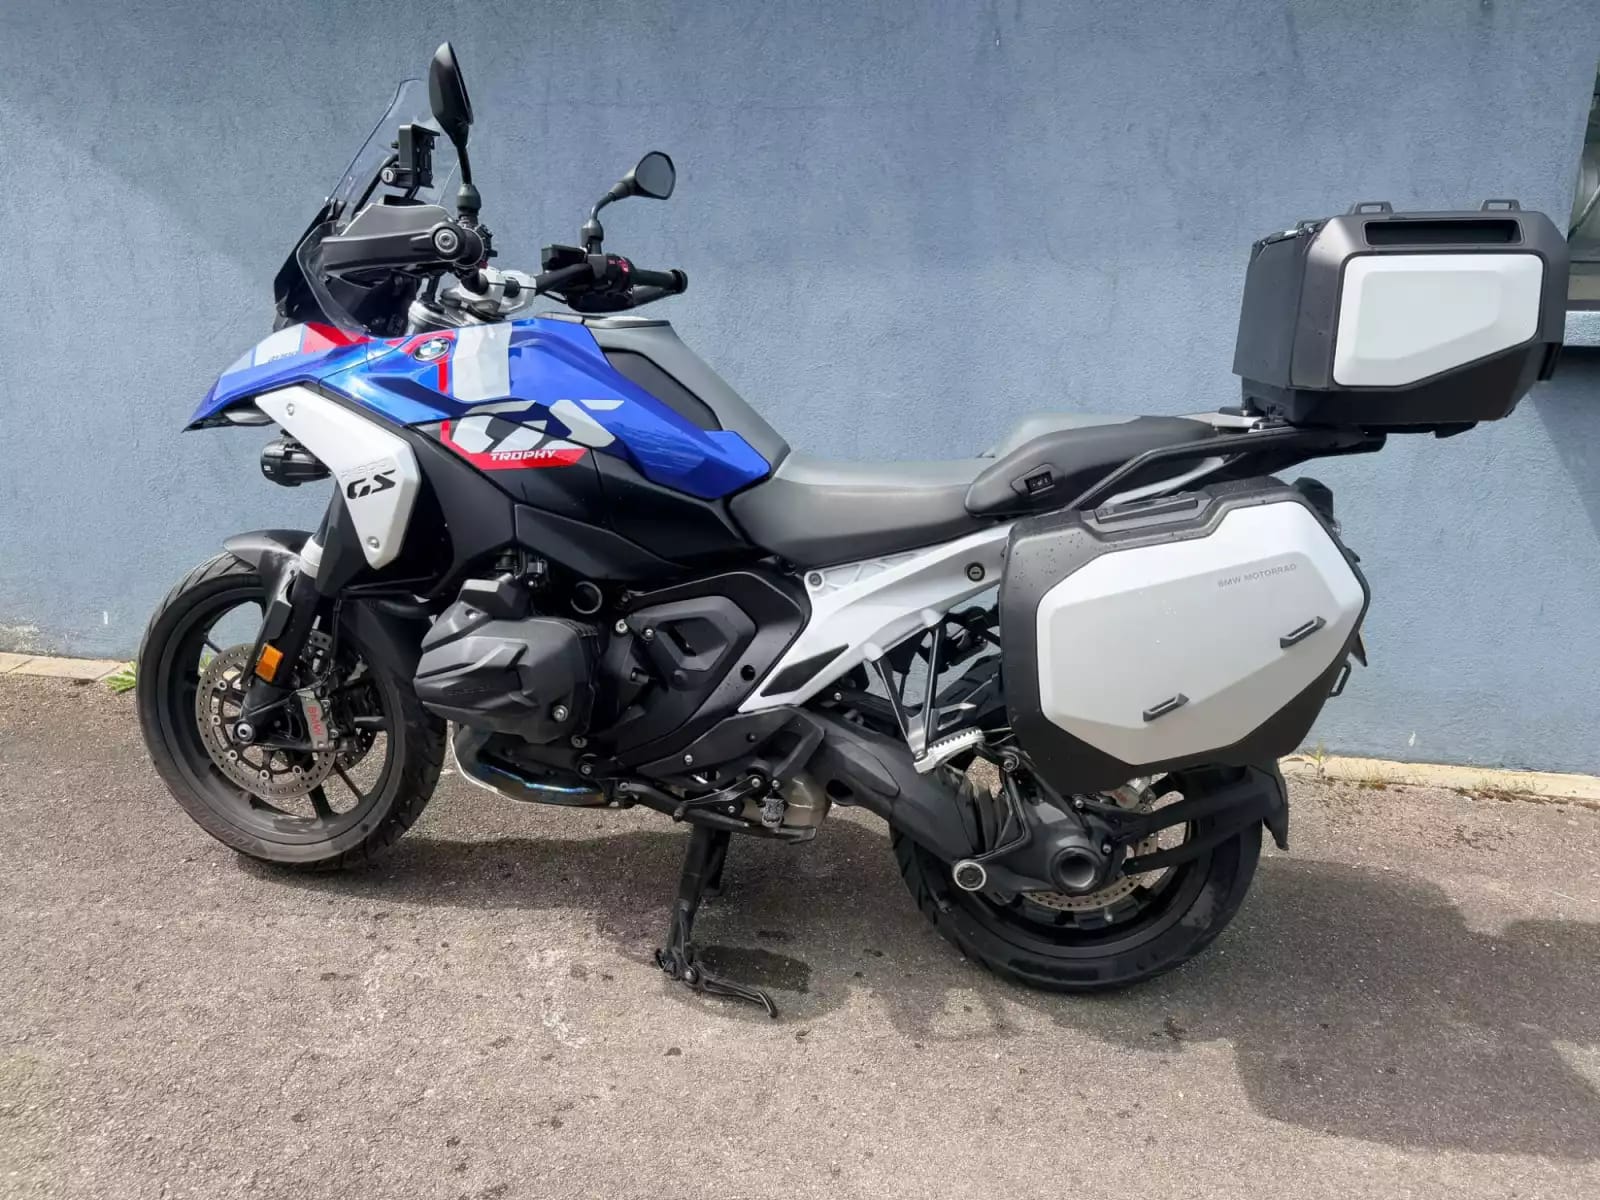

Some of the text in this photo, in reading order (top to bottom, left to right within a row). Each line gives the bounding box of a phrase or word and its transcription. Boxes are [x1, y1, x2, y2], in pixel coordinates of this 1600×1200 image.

[452, 400, 624, 453] GS
[490, 449, 557, 461] TROPHY
[347, 468, 396, 499] GS
[1217, 563, 1297, 588] BMW MOTORRAD
[307, 706, 323, 736] BMW
